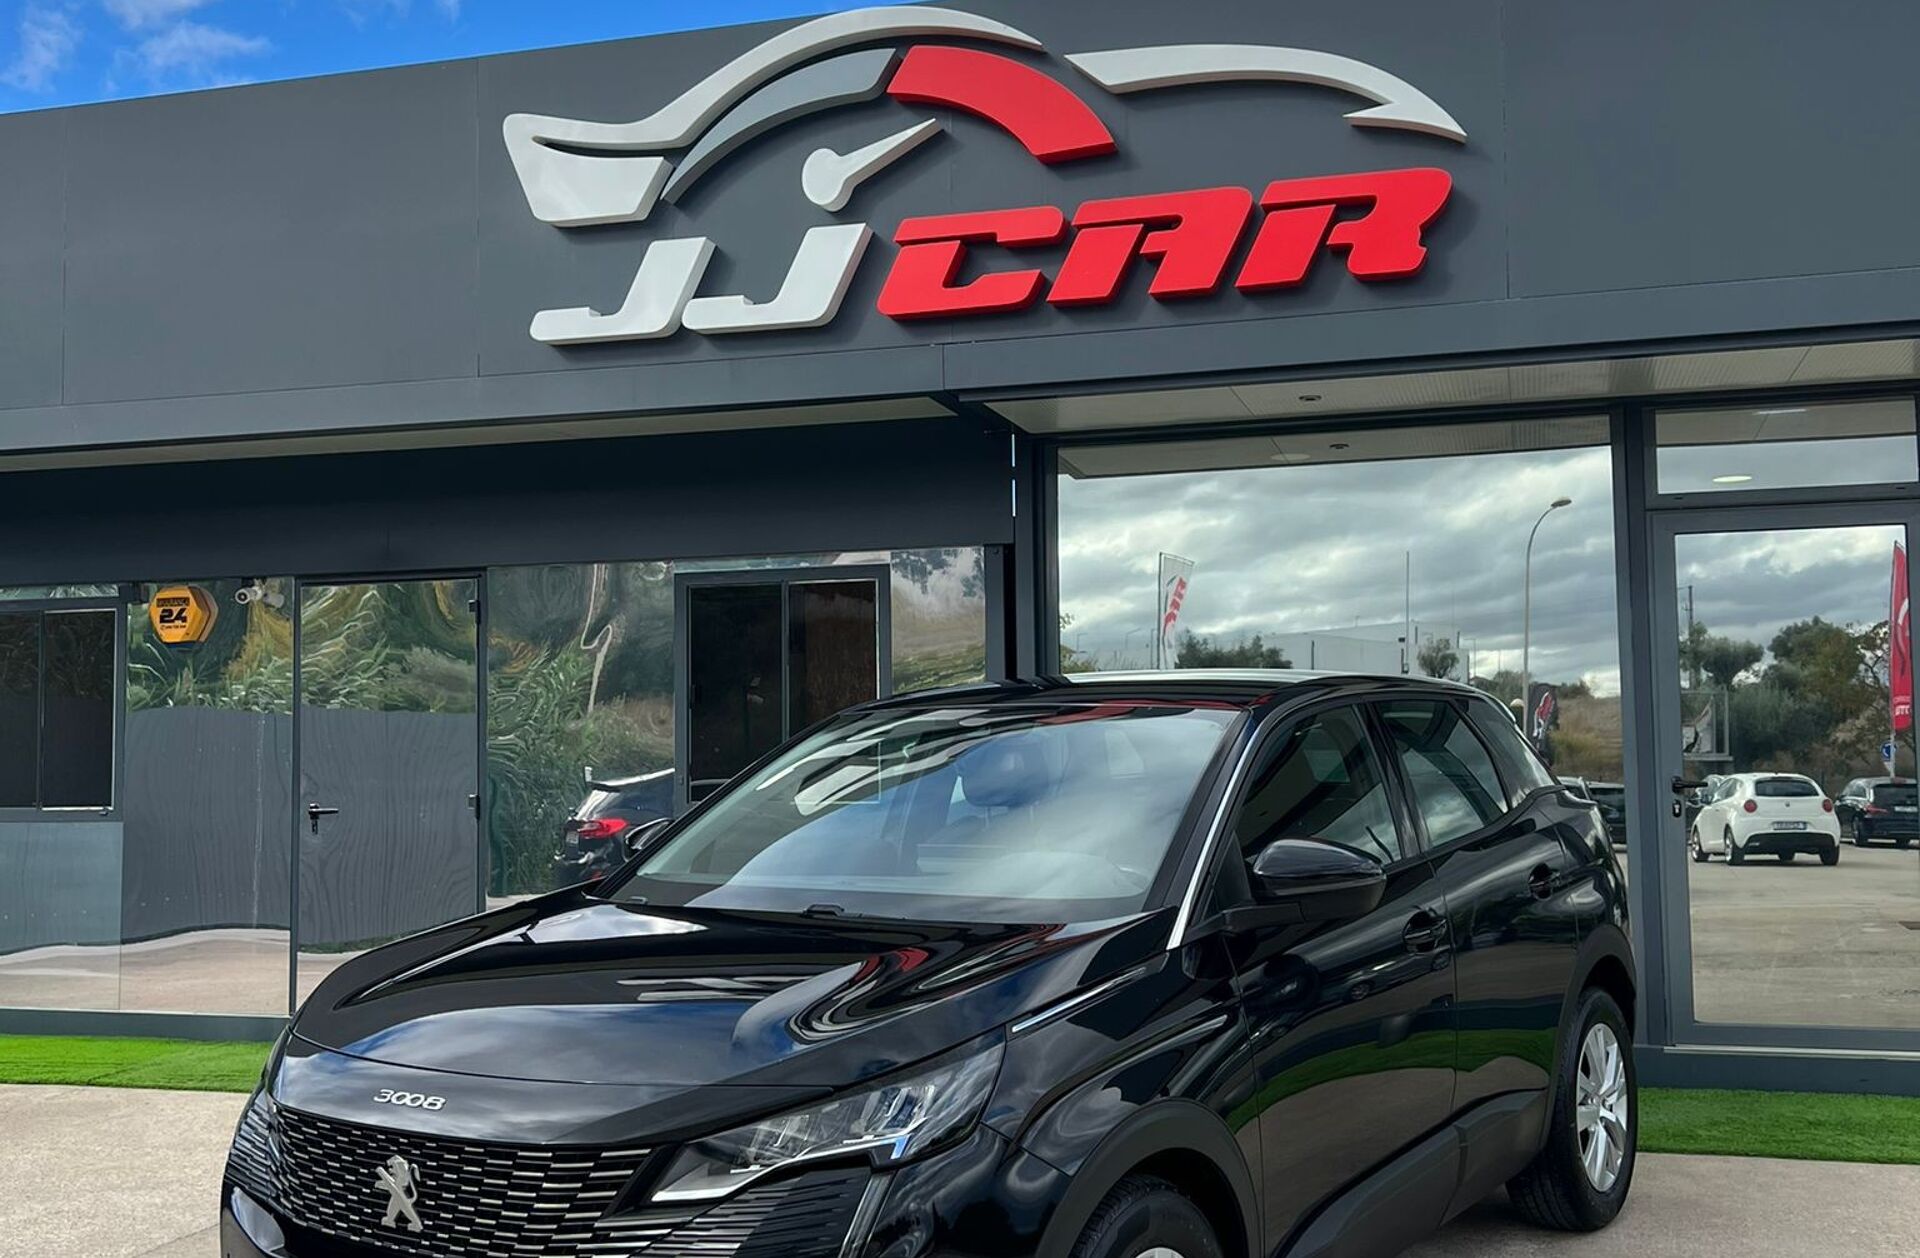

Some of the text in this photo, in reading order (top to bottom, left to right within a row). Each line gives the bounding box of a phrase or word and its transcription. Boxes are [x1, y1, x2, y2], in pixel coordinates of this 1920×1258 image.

[530, 167, 1453, 345] JJ CAR
[160, 608, 187, 624] 24
[373, 1089, 446, 1110] 3008
